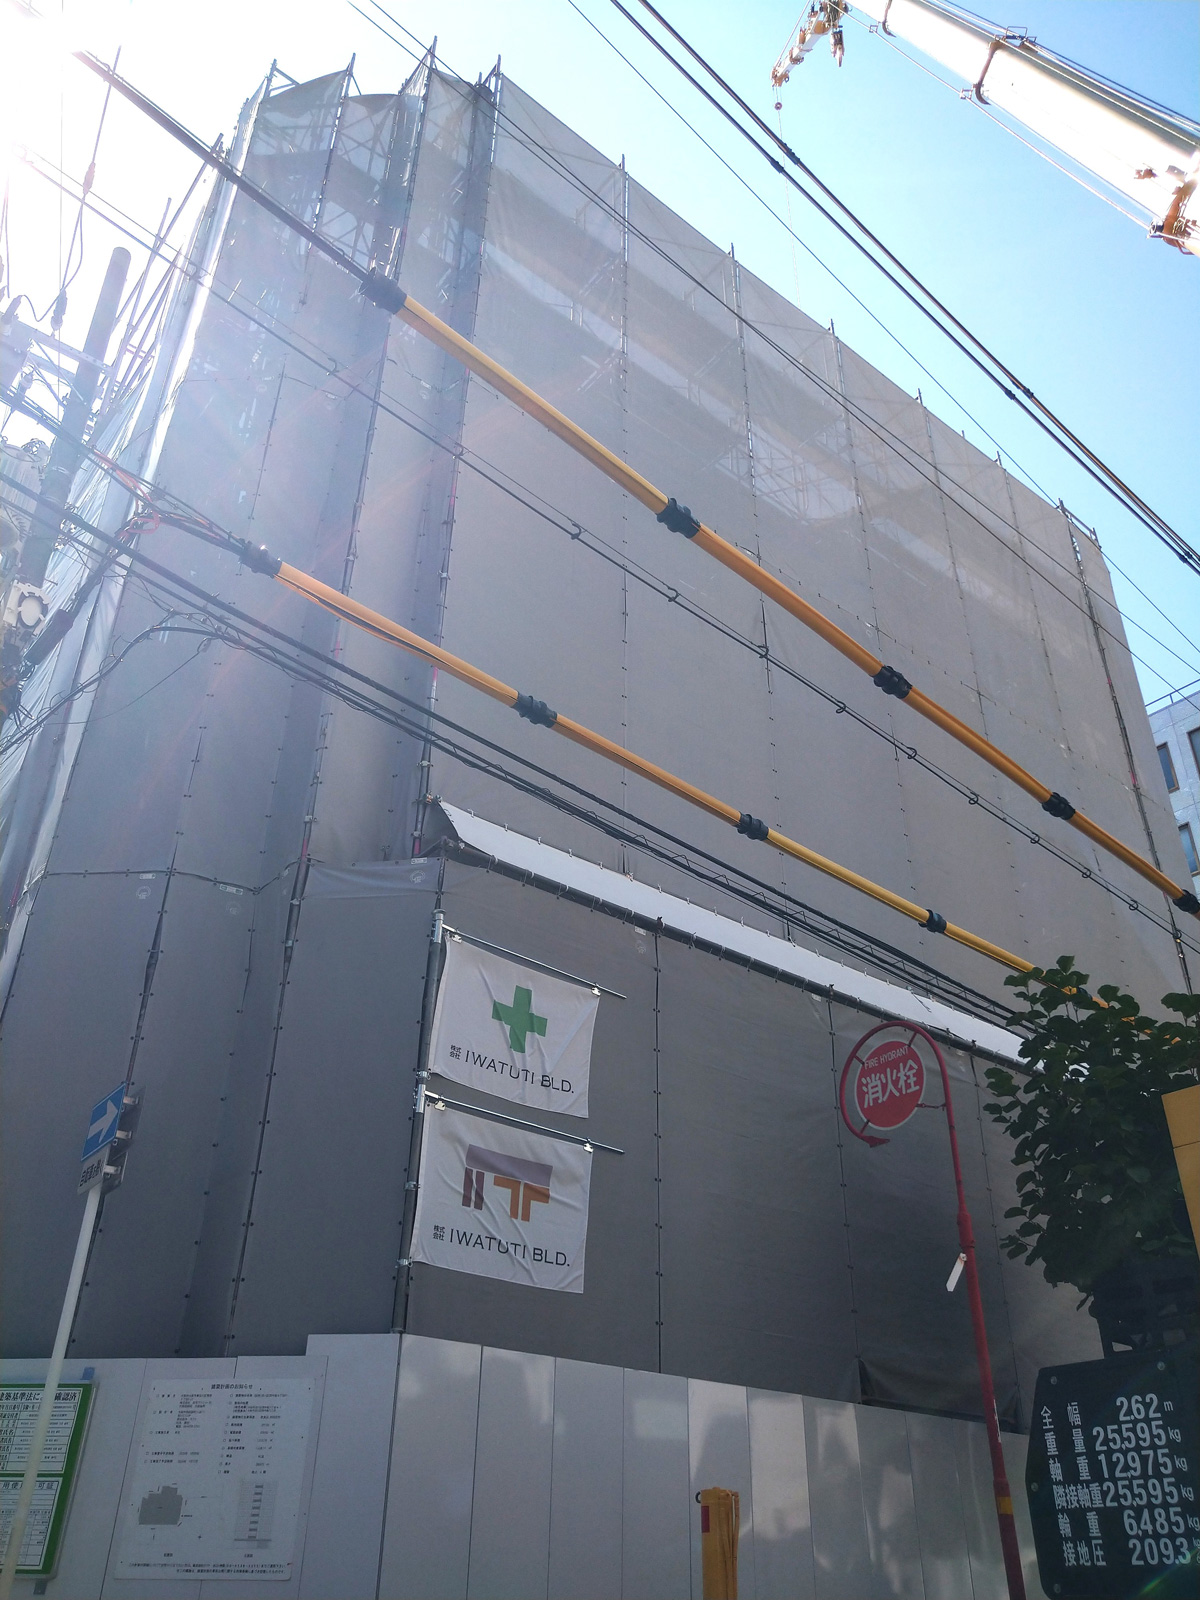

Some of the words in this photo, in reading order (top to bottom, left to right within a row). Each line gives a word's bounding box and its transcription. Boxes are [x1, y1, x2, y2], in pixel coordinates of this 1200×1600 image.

[465, 1050, 535, 1085] IWATUTI
[541, 1074, 575, 1094] BLD.
[864, 1056, 879, 1070] FIRE
[880, 1046, 909, 1065] HYDRANT
[861, 1059, 920, 1108] 消火栓
[449, 1228, 526, 1259] IWATUTI
[532, 1248, 570, 1267] BLD.
[1115, 1393, 1162, 1422] 2.62
[1163, 1399, 1174, 1412] m
[1092, 1420, 1167, 1452] 25,595
[1167, 1426, 1182, 1443] kg
[1098, 1448, 1173, 1479] 12,975
[1173, 1455, 1188, 1471] kg
[1052, 1482, 1104, 1510] 隣接軸重
[1102, 1477, 1179, 1508] 25,595
[1180, 1484, 1195, 1501] kg
[1122, 1507, 1186, 1537] 6,485
[1186, 1514, 1200, 1531] kg
[1062, 1539, 1107, 1567] 接地圧
[1128, 1537, 1192, 1566] 209.3
